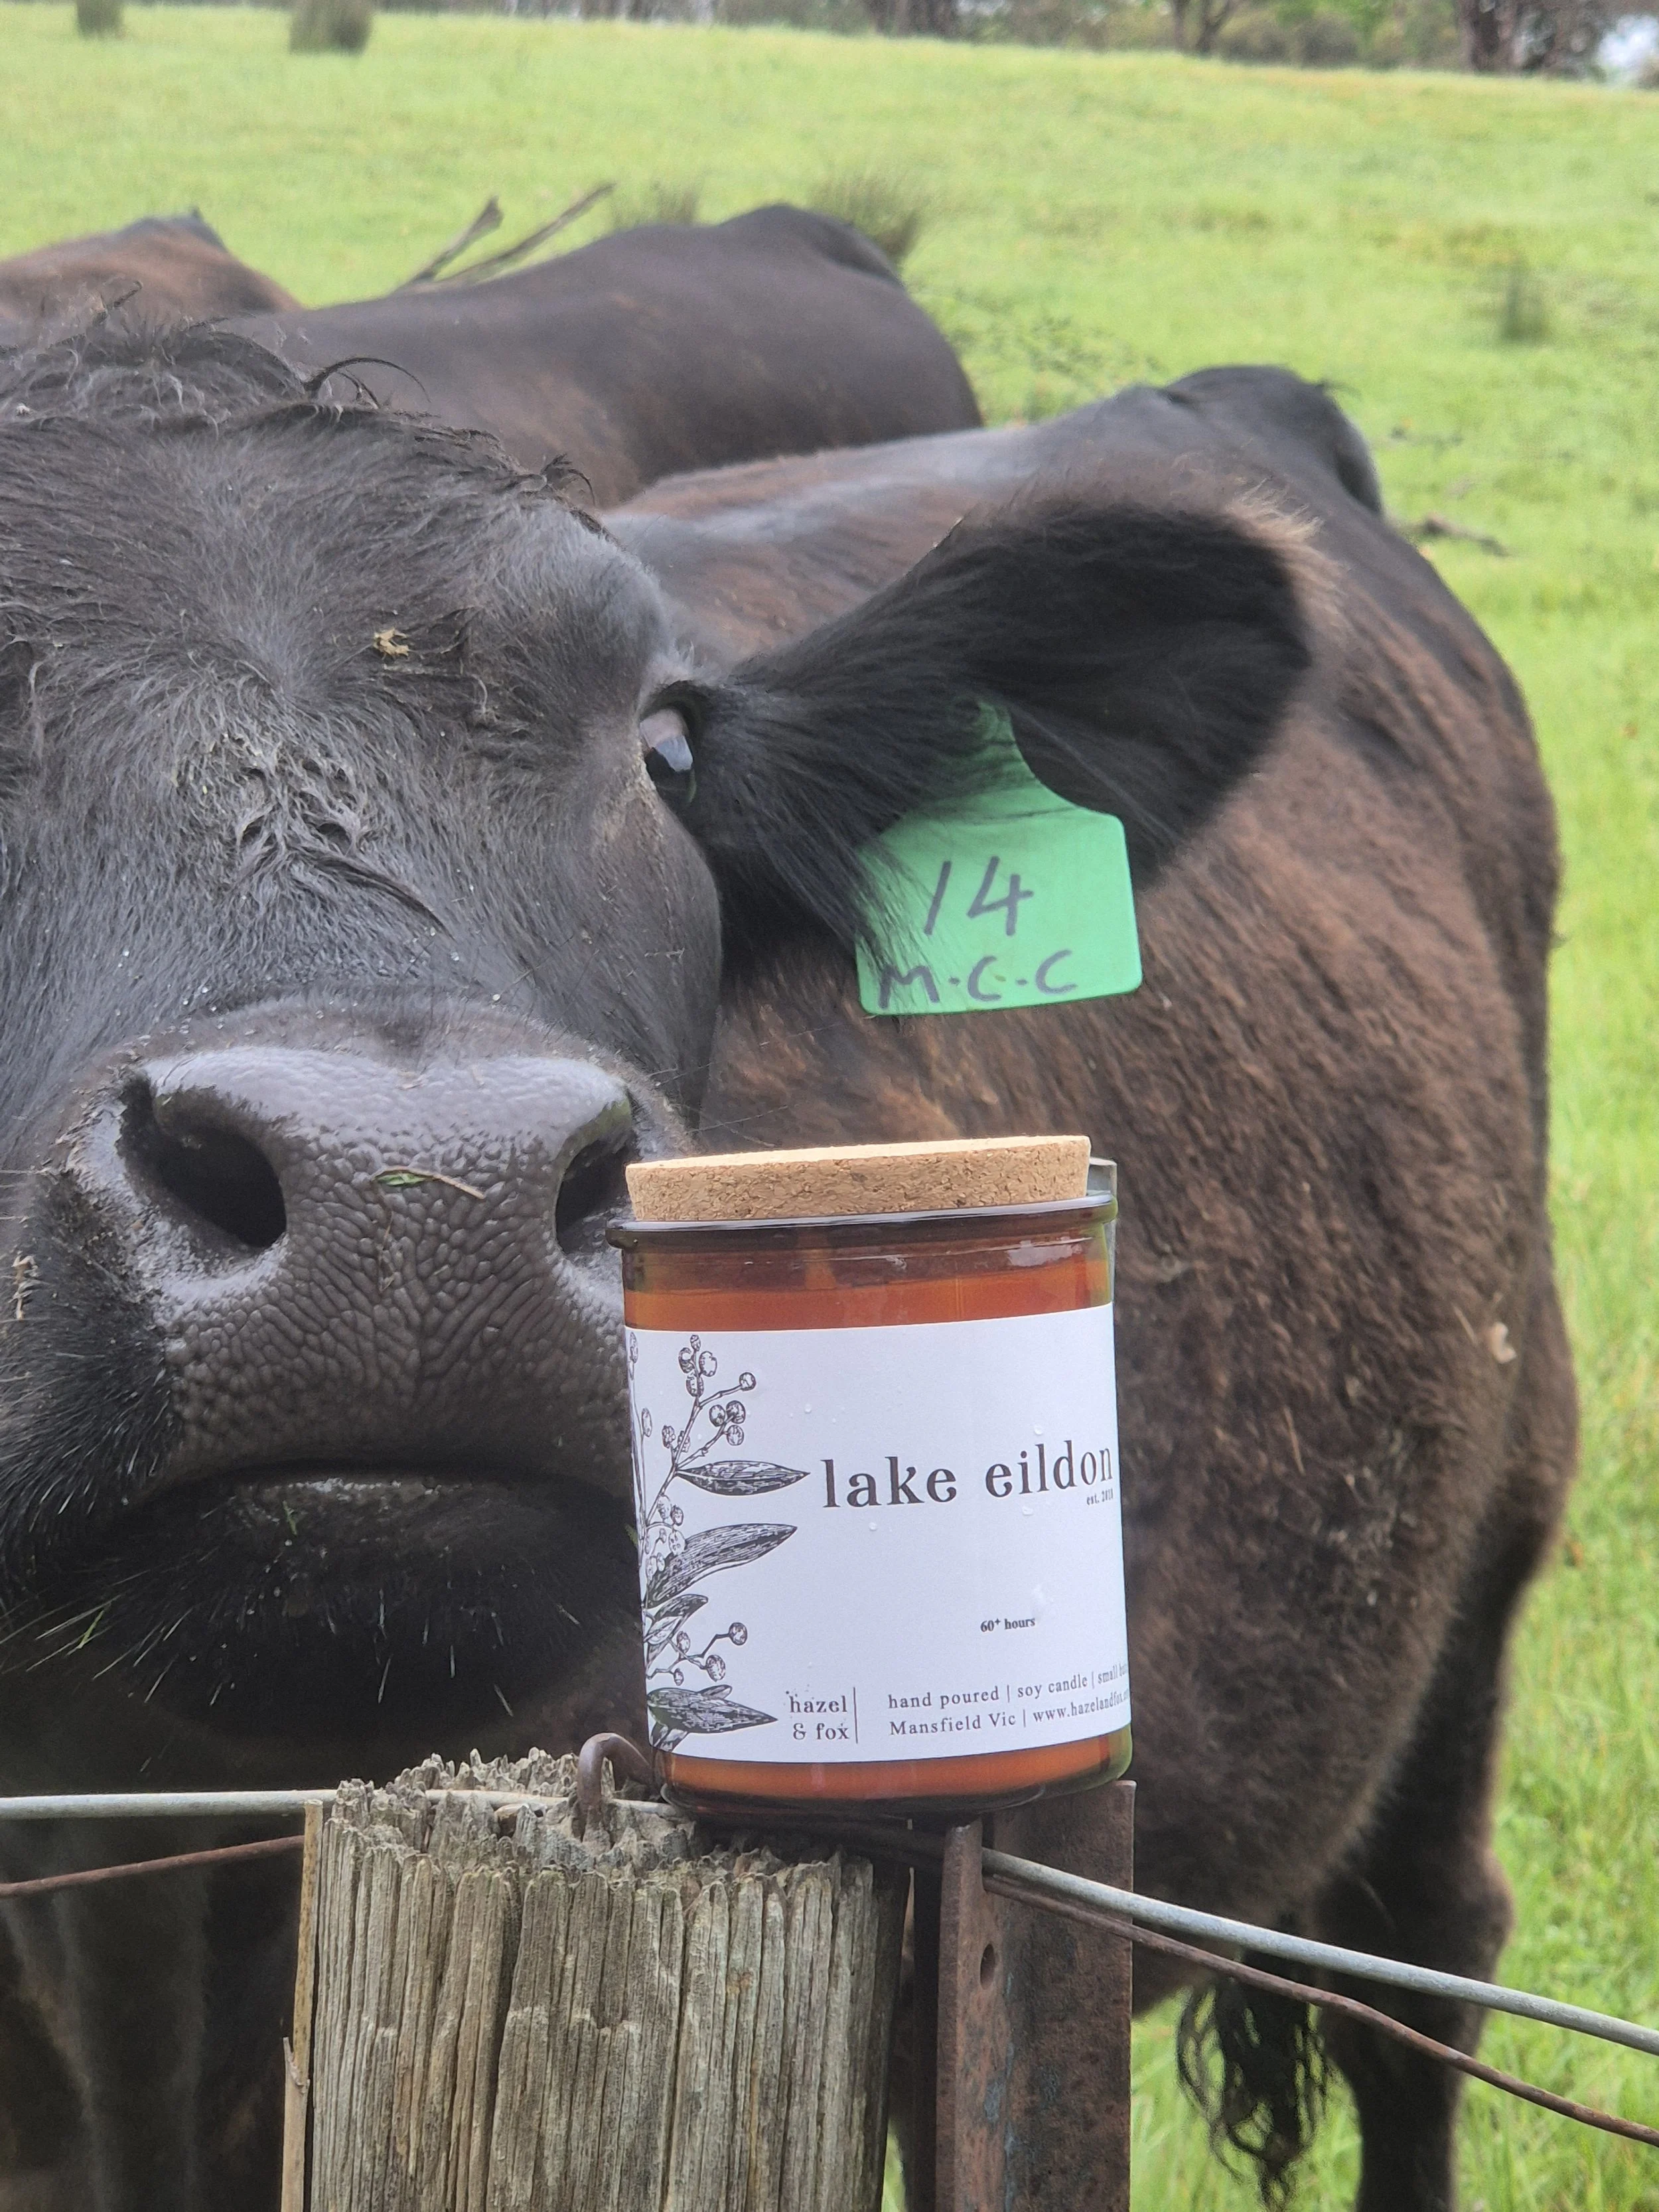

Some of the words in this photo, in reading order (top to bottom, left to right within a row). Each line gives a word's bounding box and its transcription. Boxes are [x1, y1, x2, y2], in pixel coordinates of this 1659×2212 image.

[924, 855, 1034, 936] 14
[820, 1455, 957, 1507] lake
[985, 1439, 1113, 1497] eildon
[1004, 1617, 1036, 1630] hours
[888, 1692, 932, 1709] hand
[940, 1685, 999, 1710] poured
[1017, 1684, 1043, 1699] soy
[1048, 1673, 1088, 1693] candle
[1098, 1664, 1118, 1684] small
[788, 1695, 848, 1713] hazel
[793, 1723, 806, 1739] &
[816, 1723, 850, 1739] fox
[889, 1714, 981, 1736] Mansfield
[989, 1713, 1017, 1727] Vic
